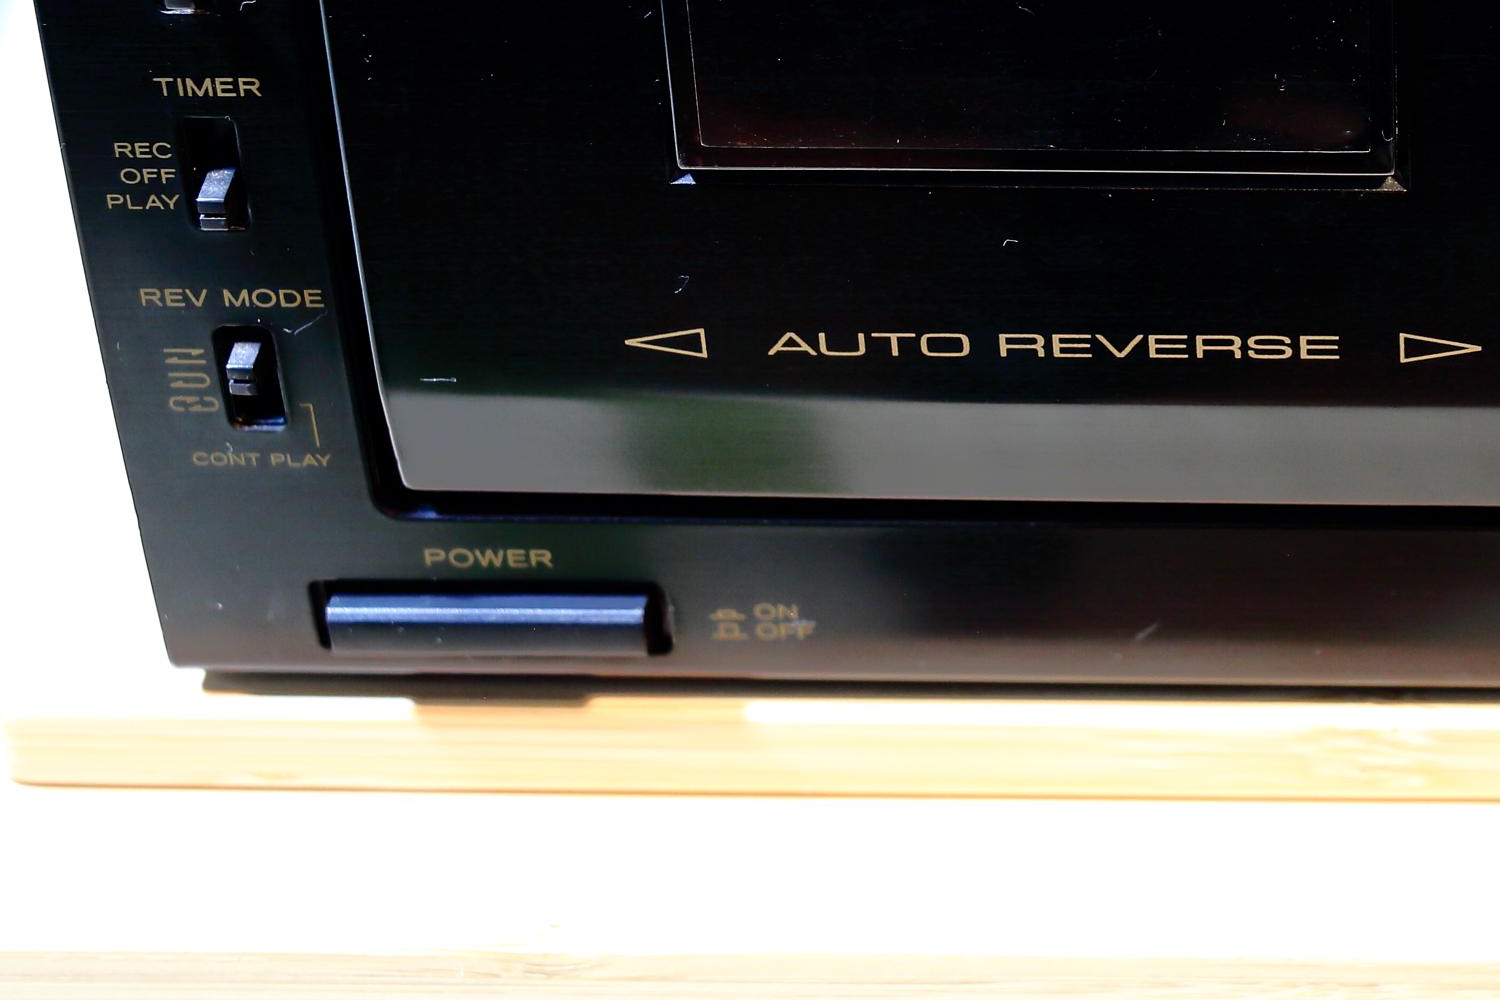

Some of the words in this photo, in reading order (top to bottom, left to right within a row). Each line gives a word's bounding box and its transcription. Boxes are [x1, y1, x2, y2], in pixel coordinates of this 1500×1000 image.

[152, 77, 262, 97] TIMER
[113, 142, 173, 159] REC
[120, 167, 176, 185] OFF
[106, 194, 180, 210] PLAY
[139, 287, 208, 308] REV
[222, 288, 325, 308] MODE
[767, 331, 971, 357] AUTO
[998, 333, 1341, 360] REVERSE
[192, 450, 260, 467] CONT
[269, 452, 330, 468] PLAY
[423, 547, 553, 568] POWER
[753, 602, 799, 620] ON
[755, 620, 816, 641] OFF
